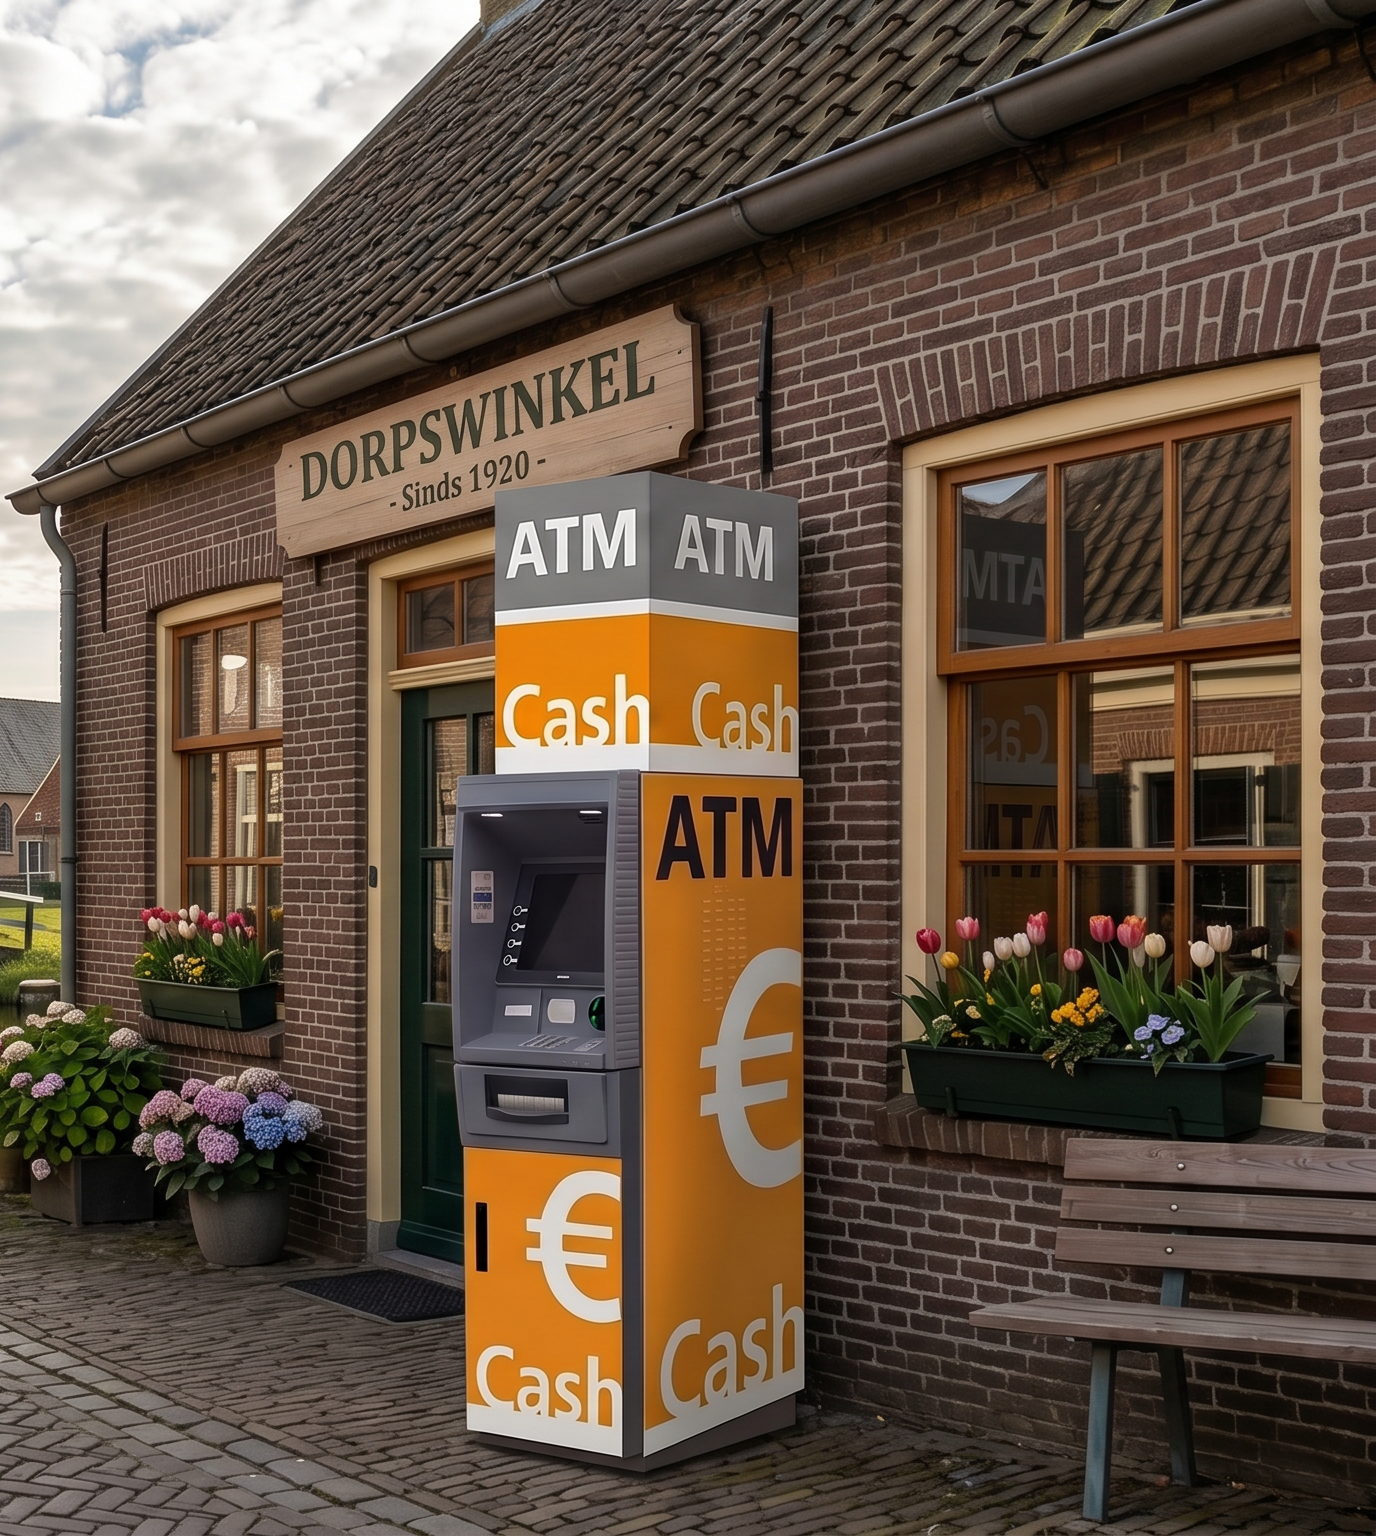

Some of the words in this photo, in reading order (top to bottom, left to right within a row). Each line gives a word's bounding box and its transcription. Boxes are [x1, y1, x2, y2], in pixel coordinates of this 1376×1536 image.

[300, 340, 655, 501] DORPSWINKEL
[402, 471, 462, 511] Sinds
[469, 450, 530, 493] 1920
[506, 508, 637, 579] ATM
[673, 513, 774, 582] ATM
[502, 673, 650, 748] Cash
[691, 681, 799, 754] Cash
[655, 795, 793, 881] ATM
[476, 1345, 623, 1428] Cash
[659, 1283, 805, 1420] Cash
